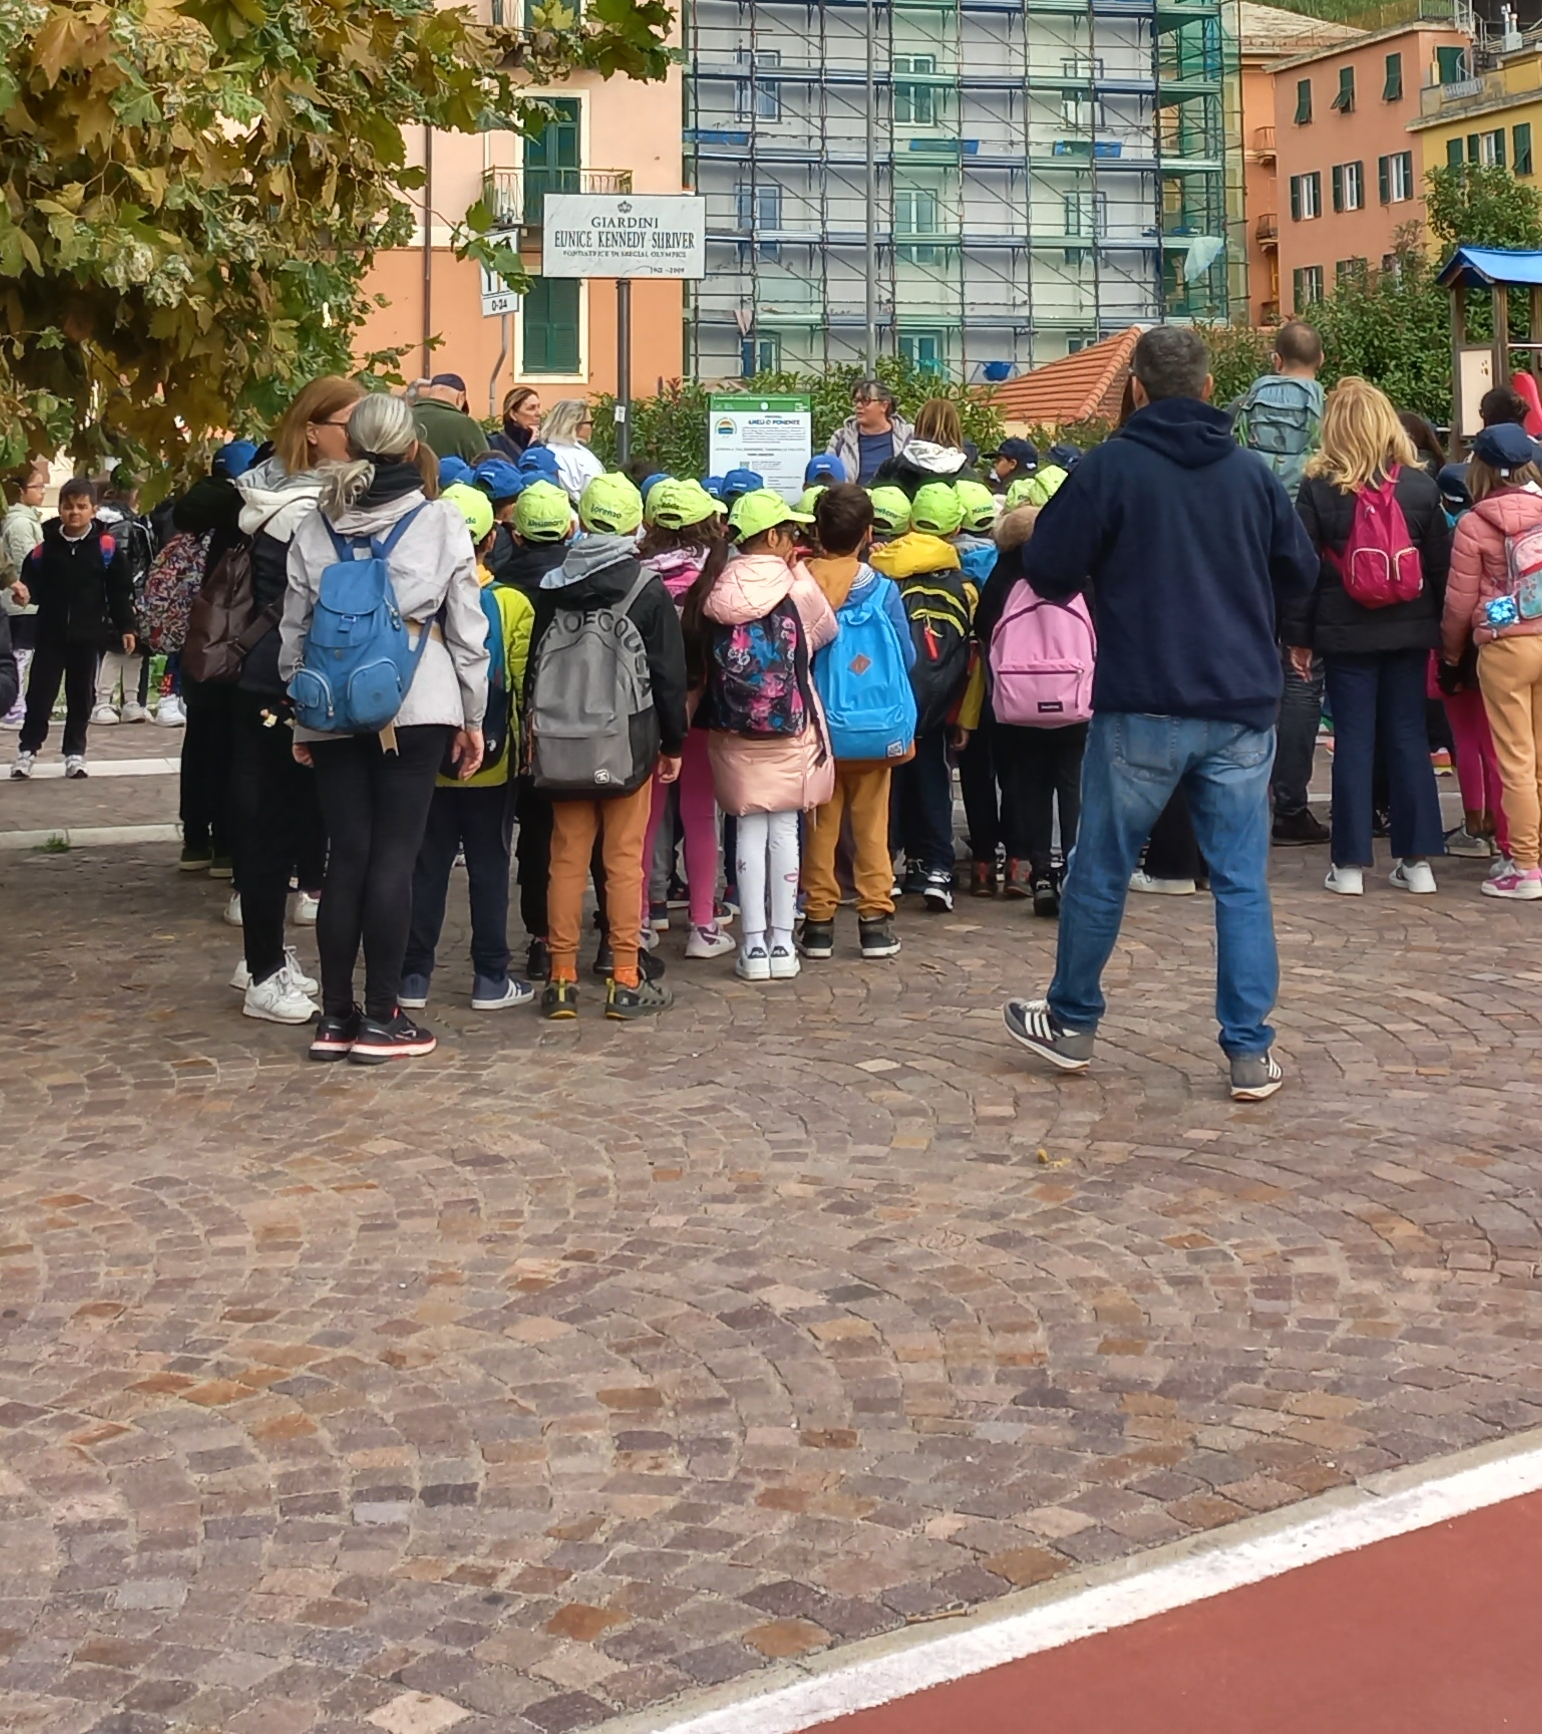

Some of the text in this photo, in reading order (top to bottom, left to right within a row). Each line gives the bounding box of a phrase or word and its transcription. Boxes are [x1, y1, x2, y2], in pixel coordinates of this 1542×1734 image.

[591, 216, 659, 229] GIARDINI
[554, 230, 593, 248] EUNICE
[491, 298, 508, 312] 0-24
[590, 503, 622, 520] Lorenzo
